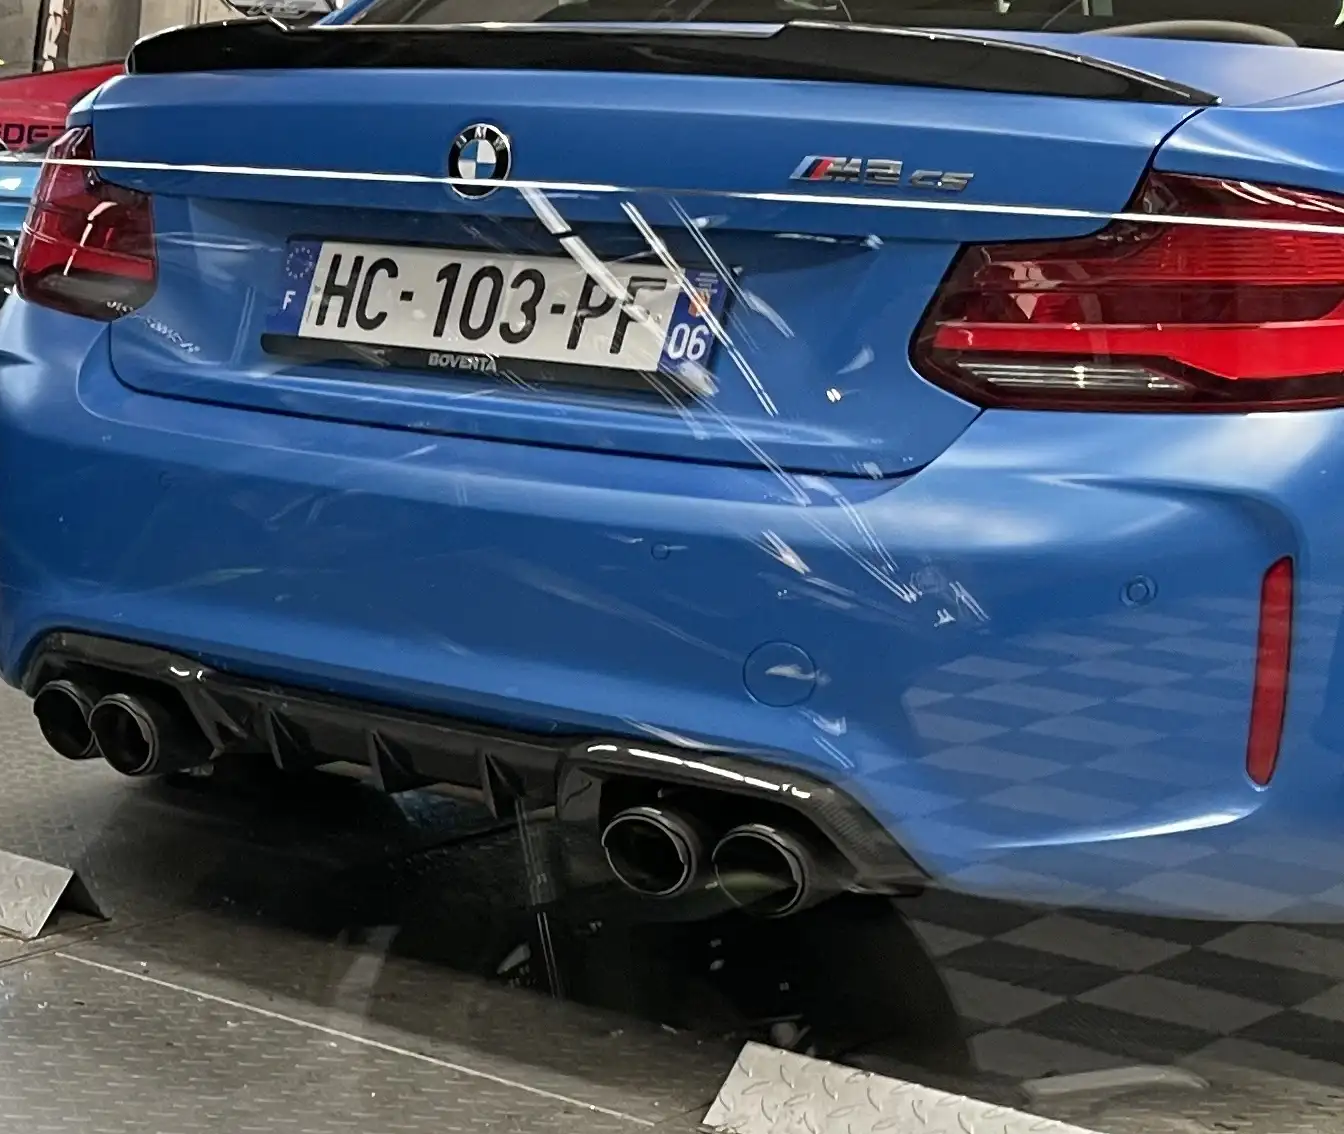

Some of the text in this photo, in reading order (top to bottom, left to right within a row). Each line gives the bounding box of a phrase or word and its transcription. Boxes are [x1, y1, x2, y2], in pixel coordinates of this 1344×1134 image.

[281, 289, 297, 311] F
[315, 252, 668, 355] HC-103-PF
[667, 322, 710, 361] 06
[427, 351, 498, 373] BOVENTA
